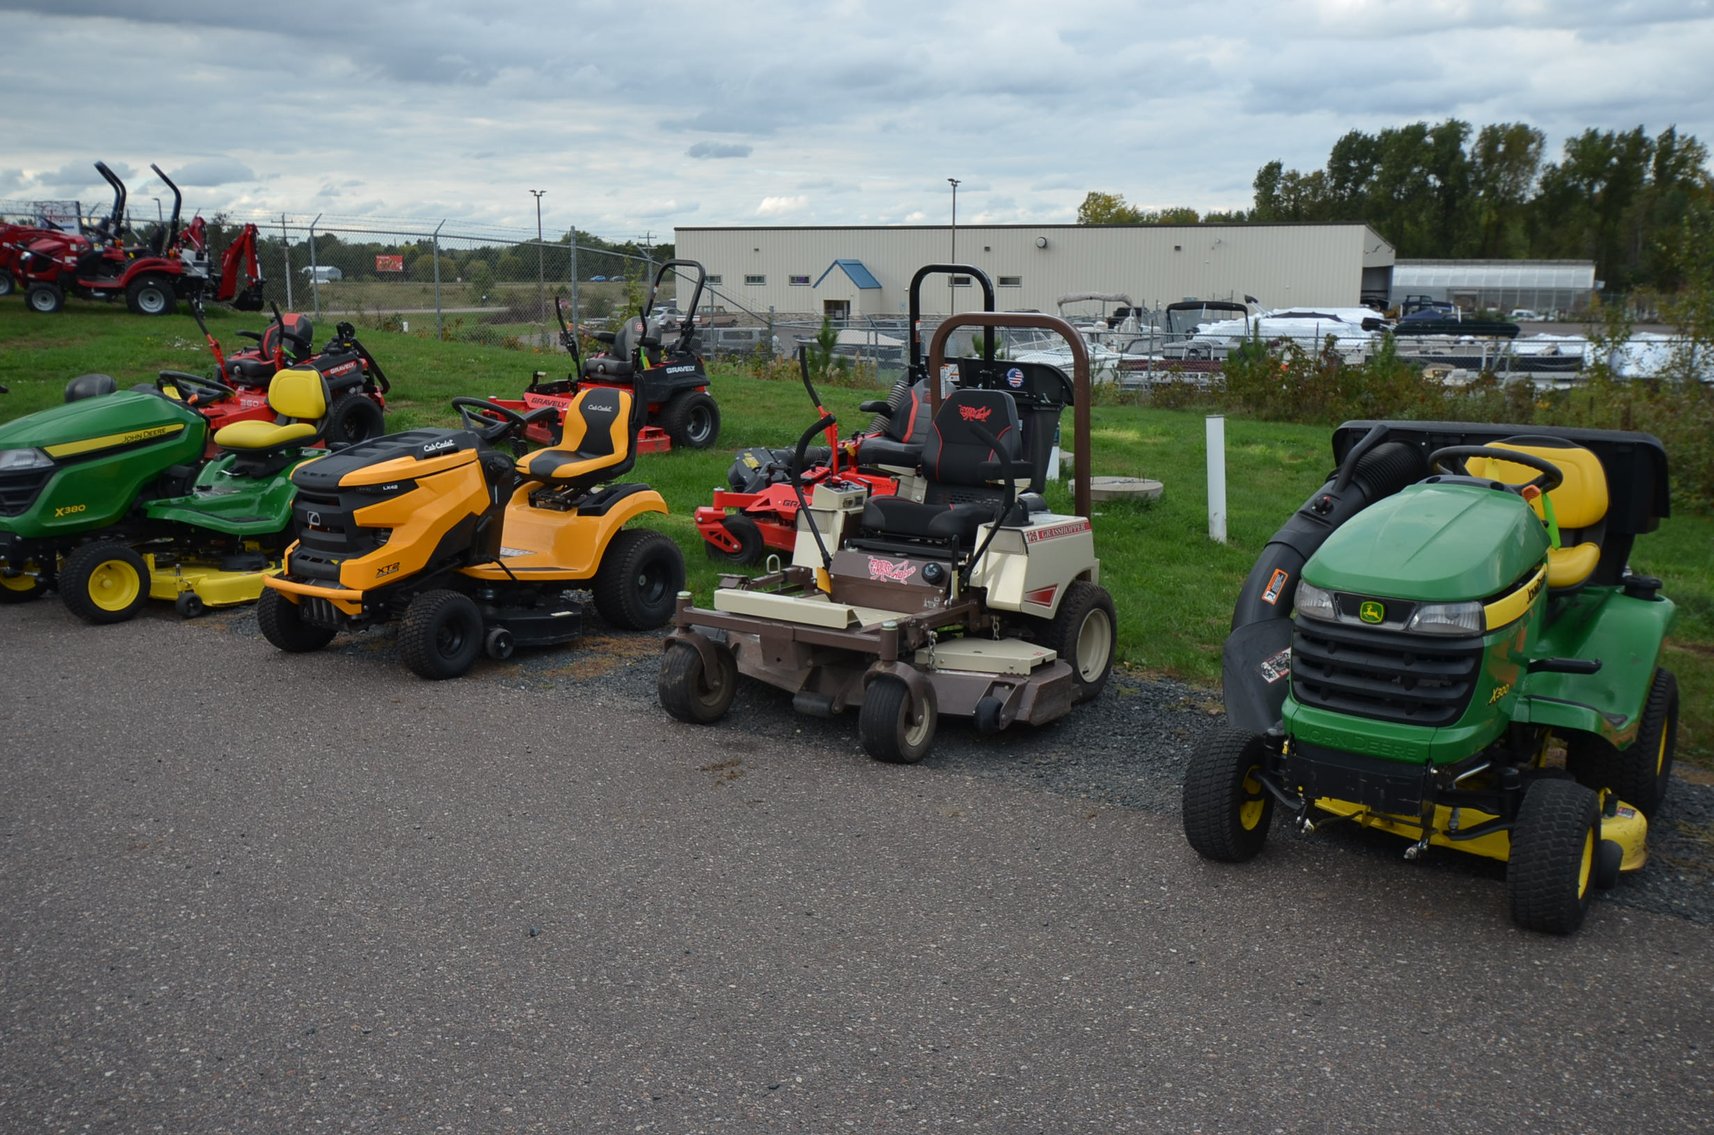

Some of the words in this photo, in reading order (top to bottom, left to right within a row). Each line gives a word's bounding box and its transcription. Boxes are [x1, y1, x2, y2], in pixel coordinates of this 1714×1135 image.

[329, 360, 358, 374] GRAVELY
[665, 365, 696, 374] GRAVELY
[531, 397, 568, 408] GRAVELY
[123, 431, 143, 443] JOHN
[143, 427, 166, 438] DEERE
[423, 443, 436, 452] Cub
[435, 439, 455, 449] Cadet
[54, 504, 86, 517] X380
